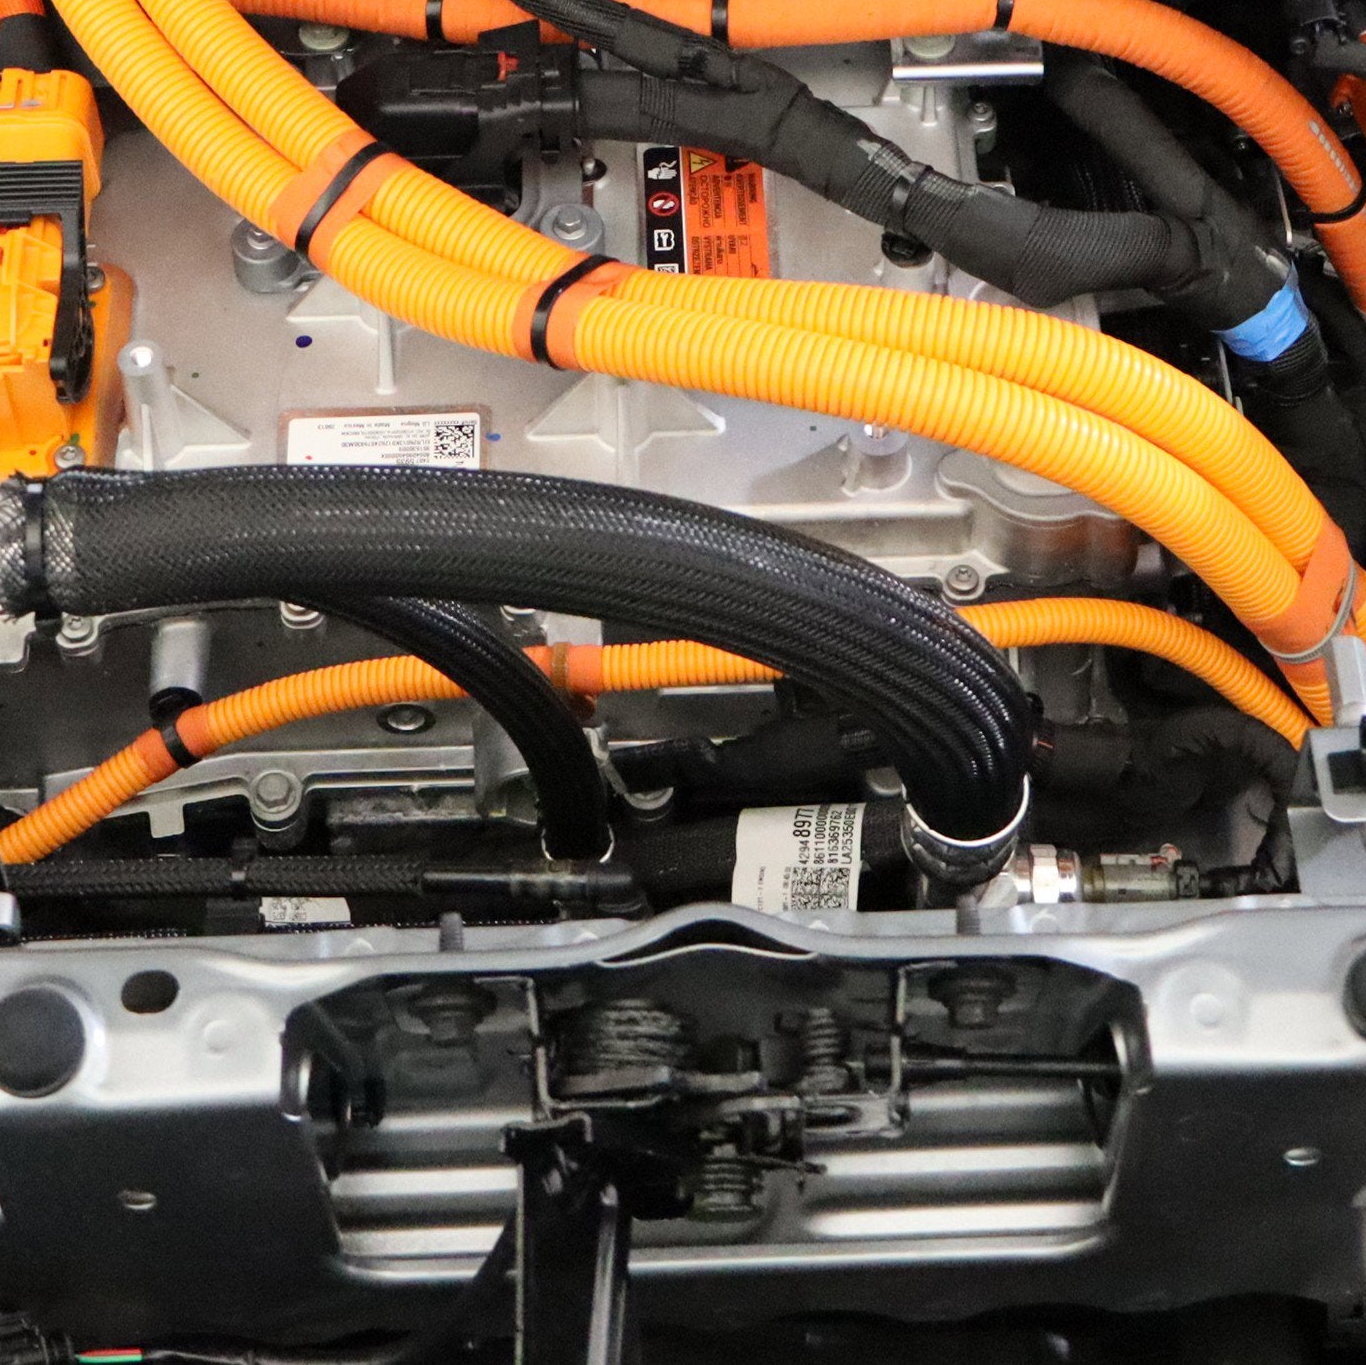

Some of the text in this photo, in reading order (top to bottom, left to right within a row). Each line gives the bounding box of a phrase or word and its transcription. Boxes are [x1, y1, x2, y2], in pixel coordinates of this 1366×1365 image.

[700, 175, 710, 228] ОСТОРОЖНО
[728, 235, 736, 254] UYARI
[827, 810, 842, 864] 816369762
